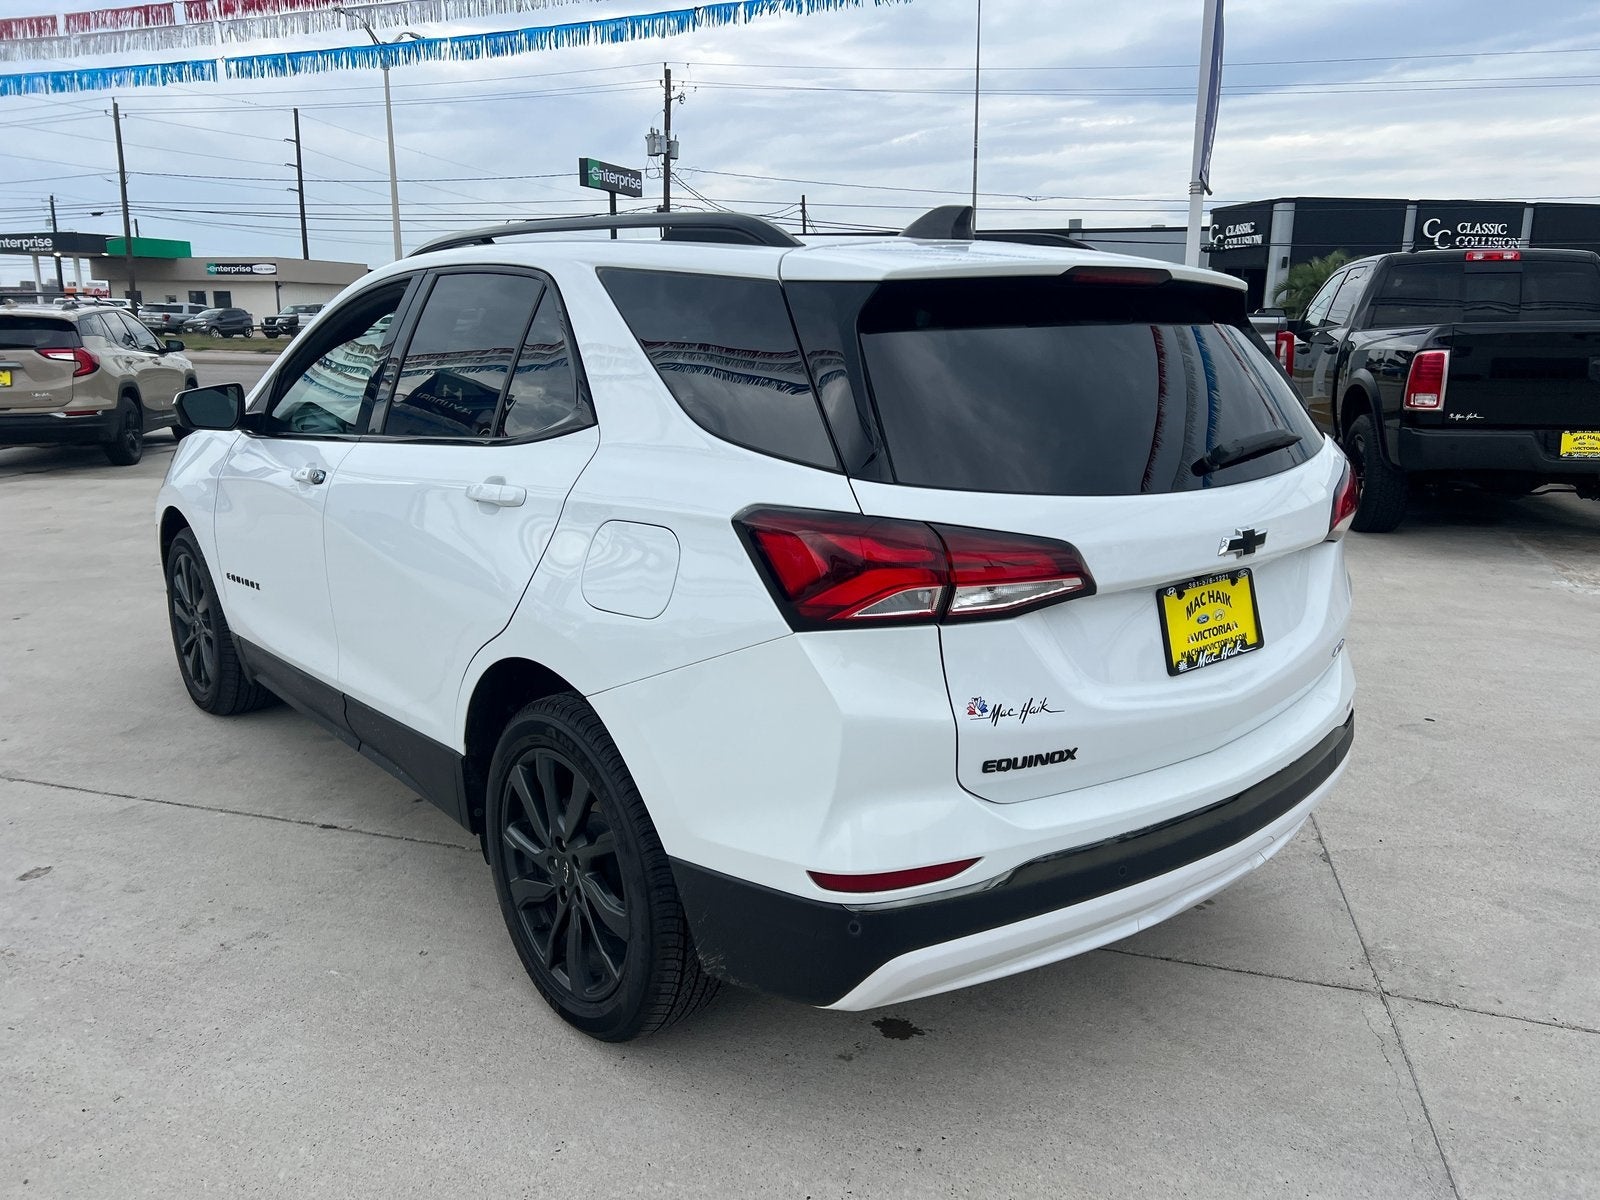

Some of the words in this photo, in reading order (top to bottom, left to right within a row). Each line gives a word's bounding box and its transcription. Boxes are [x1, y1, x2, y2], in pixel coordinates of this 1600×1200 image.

[588, 166, 642, 190] enterprise
[1225, 221, 1256, 236] CLASSIC
[1456, 222, 1508, 235] CLASSIC
[1455, 235, 1522, 249] COLLISION
[208, 264, 252, 274] enterprise
[1573, 434, 1587, 443] MAC
[226, 572, 261, 591] EQUINOX
[1185, 591, 1207, 621] MAC
[1207, 589, 1233, 608] HAIK
[1193, 622, 1232, 642] VICTORIA
[1196, 650, 1221, 668] Mac
[1220, 639, 1257, 660] Haik
[985, 703, 1018, 727] Mac
[1019, 697, 1065, 724] Haik
[982, 747, 1078, 774] EQUINOX
